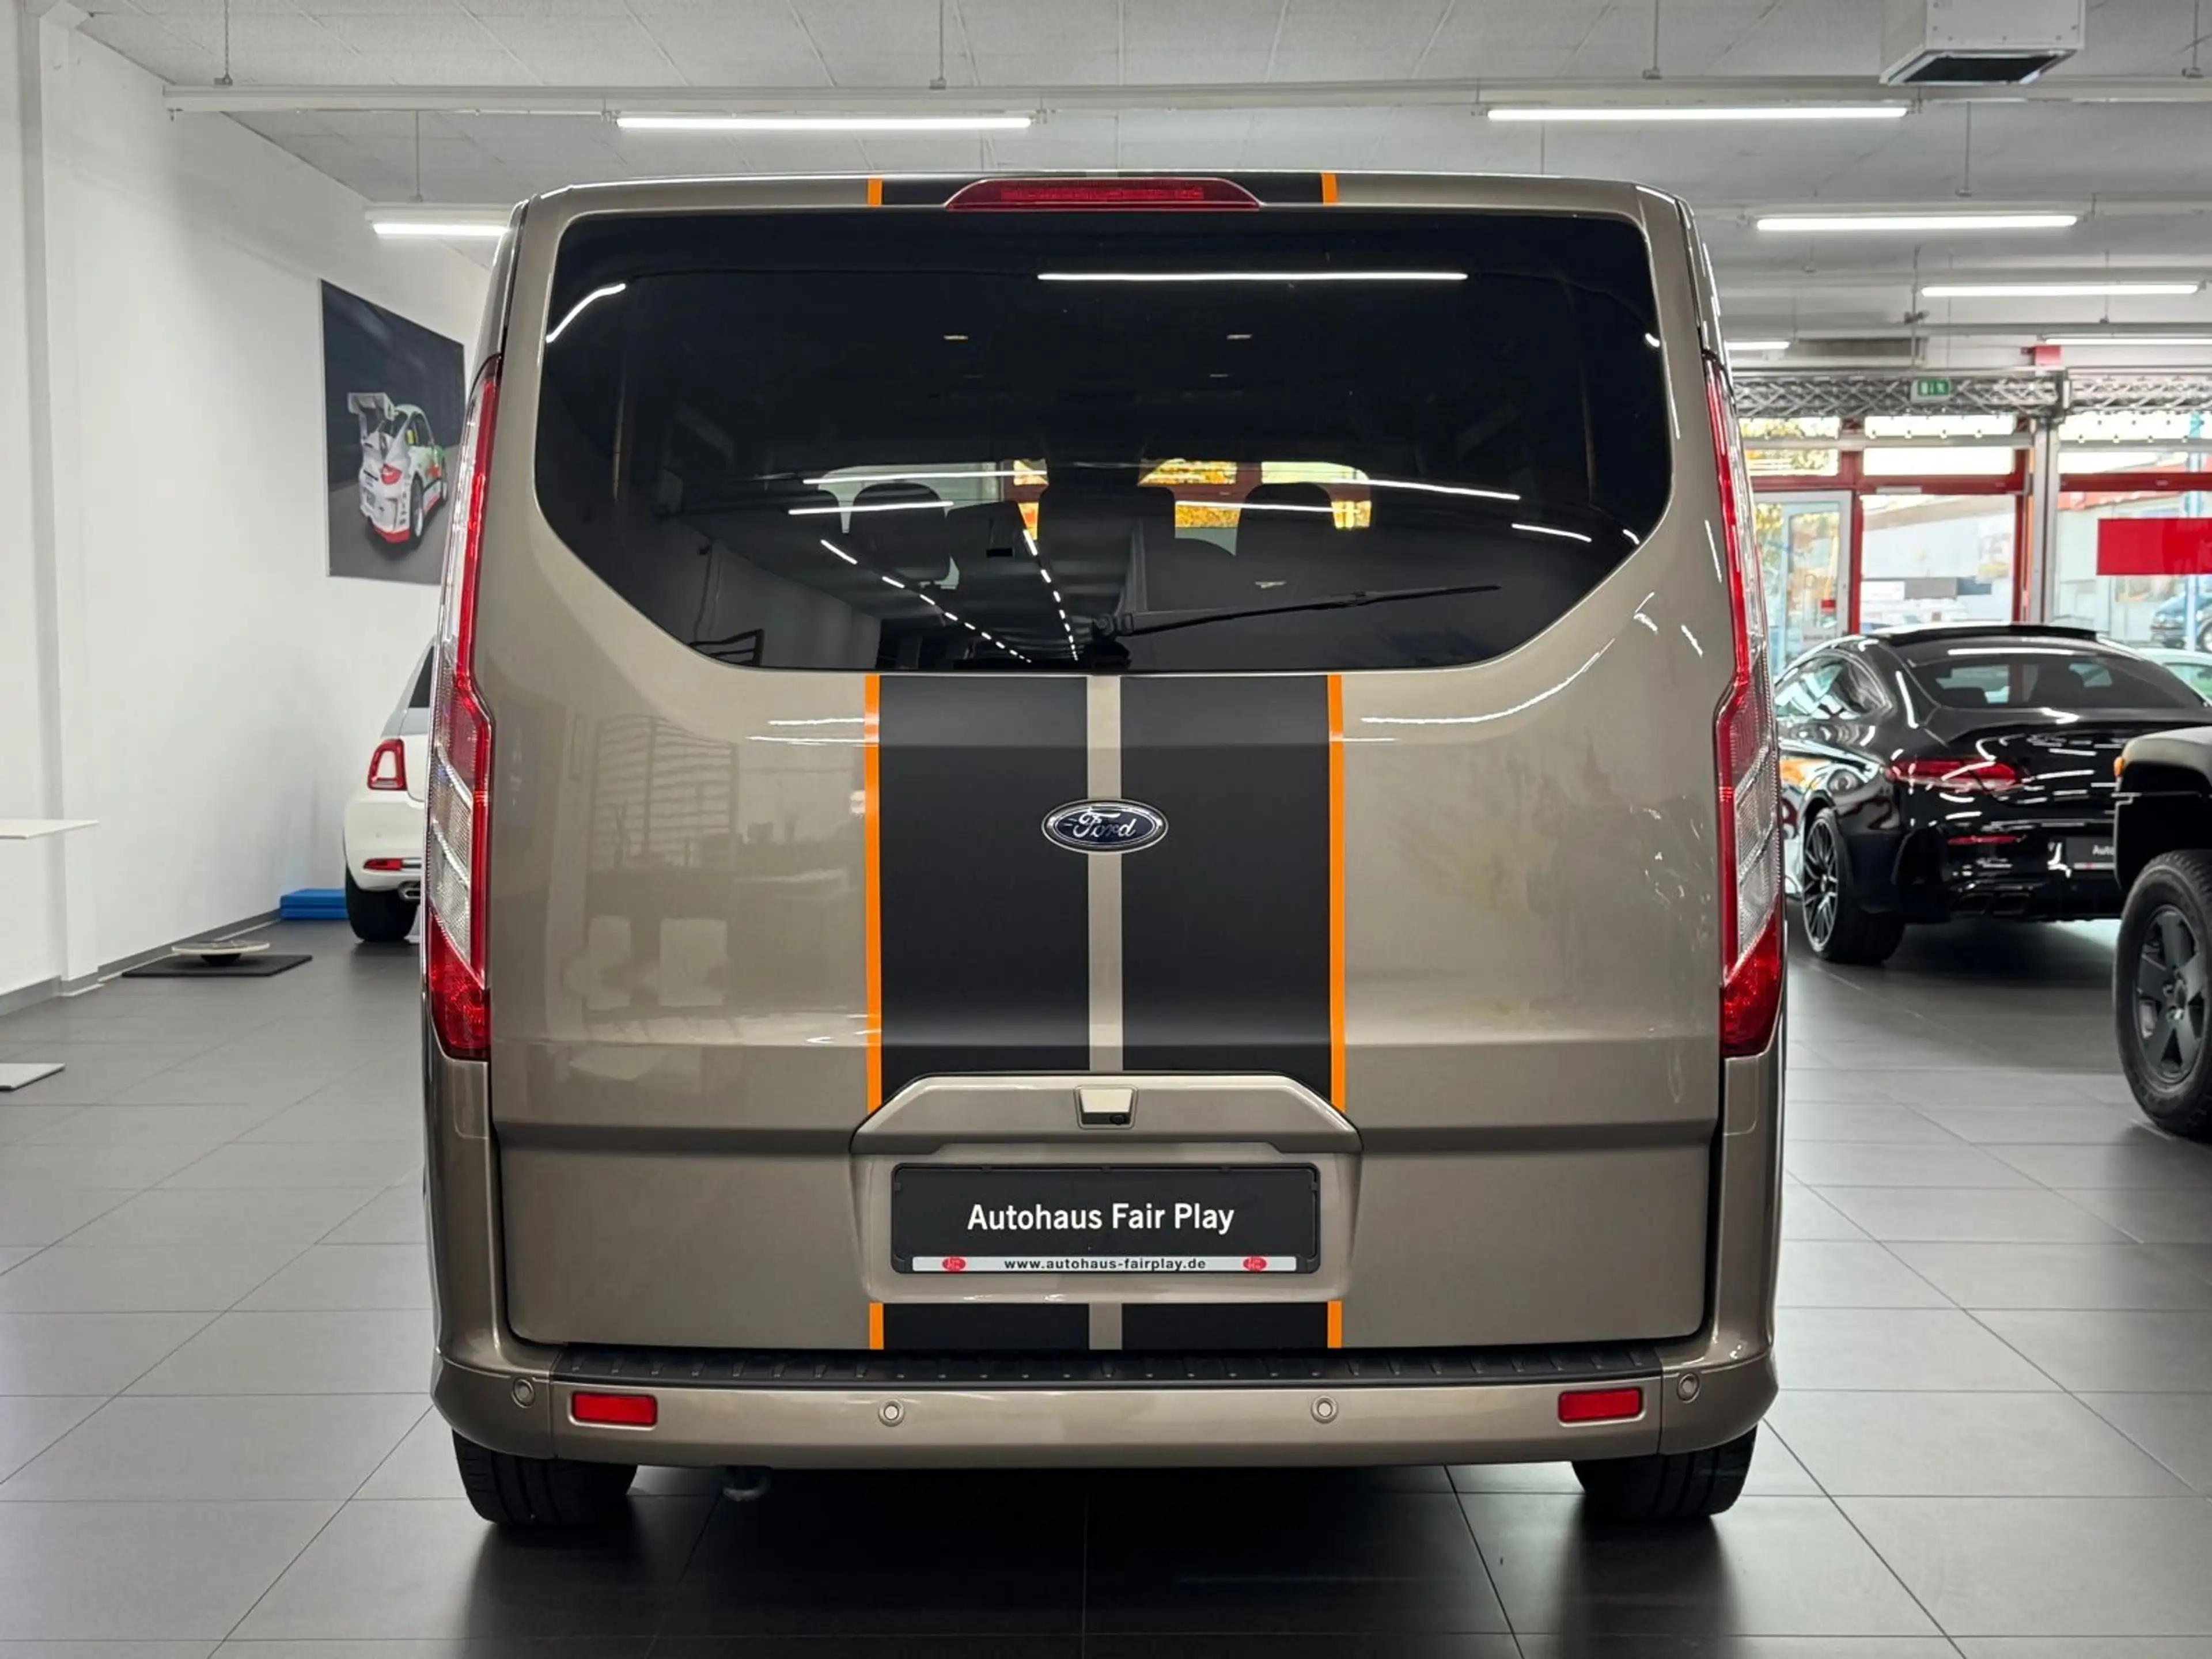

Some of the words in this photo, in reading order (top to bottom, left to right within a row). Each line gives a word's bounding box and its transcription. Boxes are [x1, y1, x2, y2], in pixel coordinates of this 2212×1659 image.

[1073, 807, 1137, 838] Ford
[967, 1204, 1103, 1230] Autohaus
[1112, 1203, 1165, 1229] Fair
[1175, 1203, 1234, 1235] Play
[1004, 1258, 1206, 1271] www.autohaus-fairplay.de
